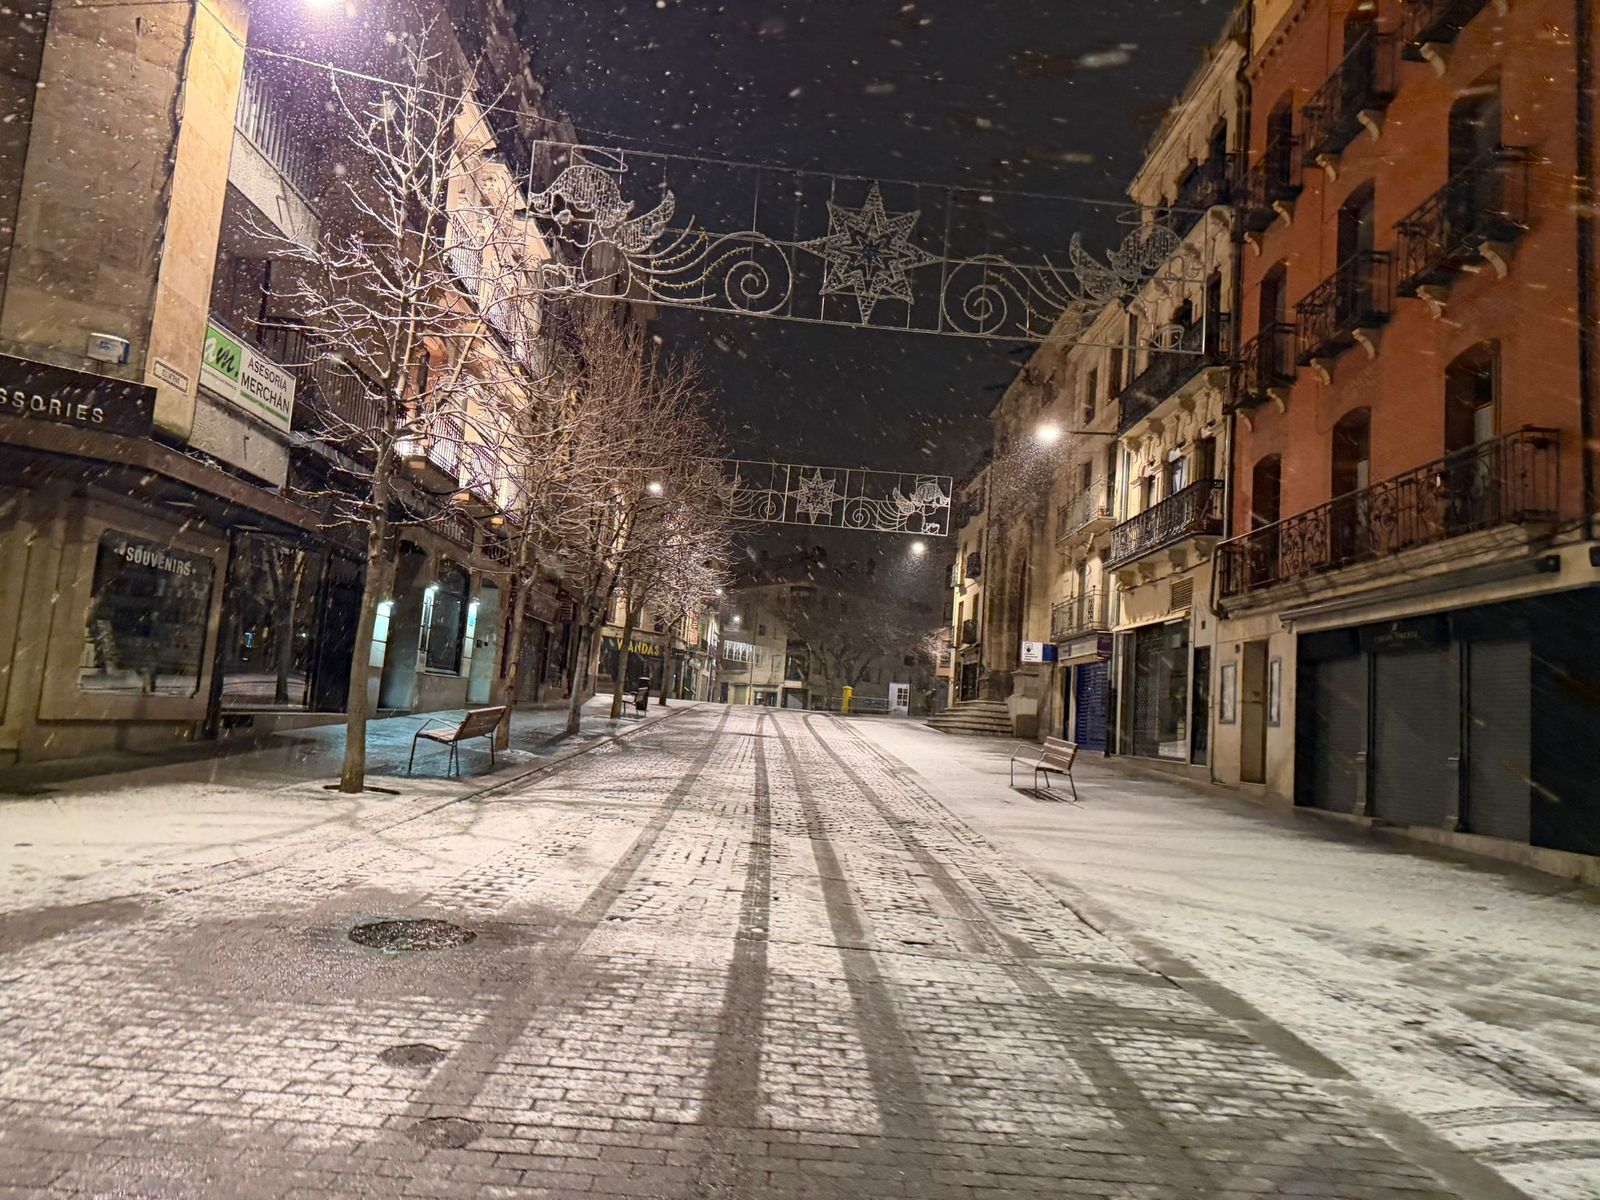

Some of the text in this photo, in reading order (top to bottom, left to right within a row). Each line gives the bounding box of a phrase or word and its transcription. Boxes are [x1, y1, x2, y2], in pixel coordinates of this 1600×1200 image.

[240, 372, 291, 414] MERCHÁN
[247, 357, 288, 393] ASESORÍA
[616, 638, 660, 656] VANDAS
